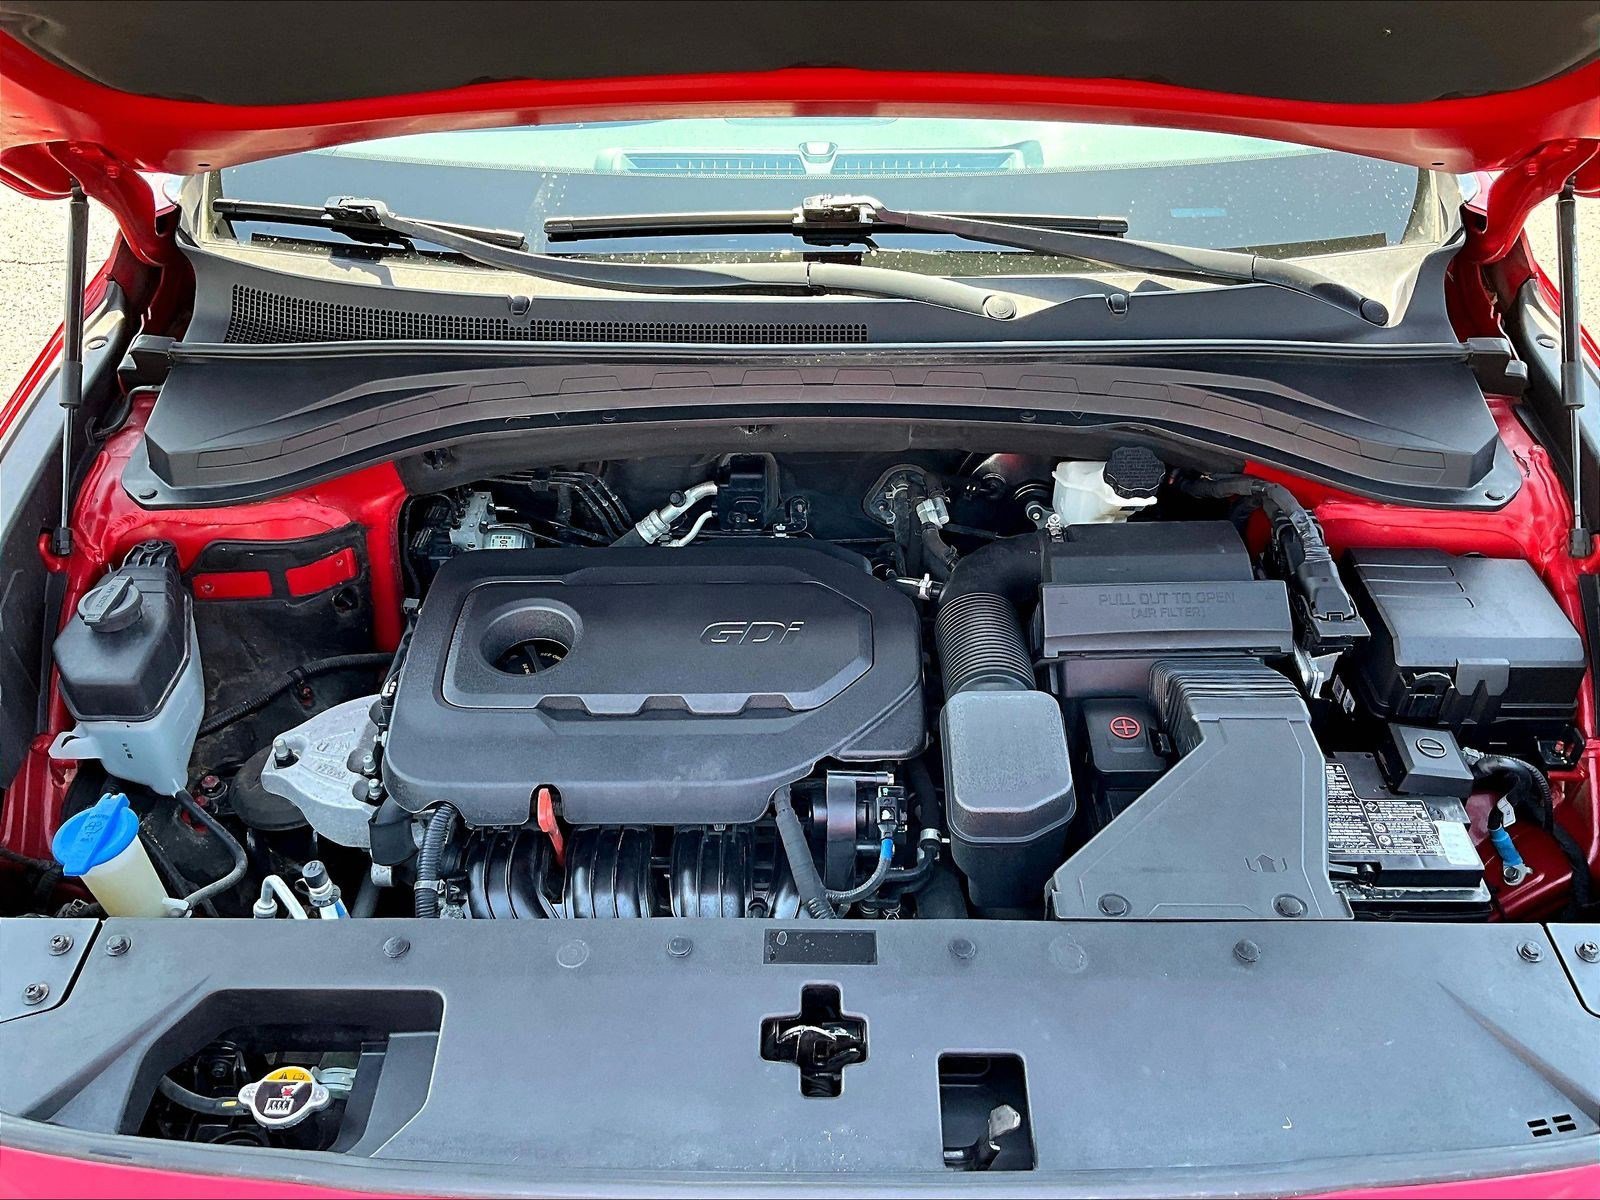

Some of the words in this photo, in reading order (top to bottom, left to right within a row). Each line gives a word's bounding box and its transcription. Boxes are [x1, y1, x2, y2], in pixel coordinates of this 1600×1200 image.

[1098, 593, 1136, 605] PULL
[1139, 592, 1168, 605] OUT
[1171, 591, 1192, 604] TO
[1196, 591, 1236, 604] OPEN
